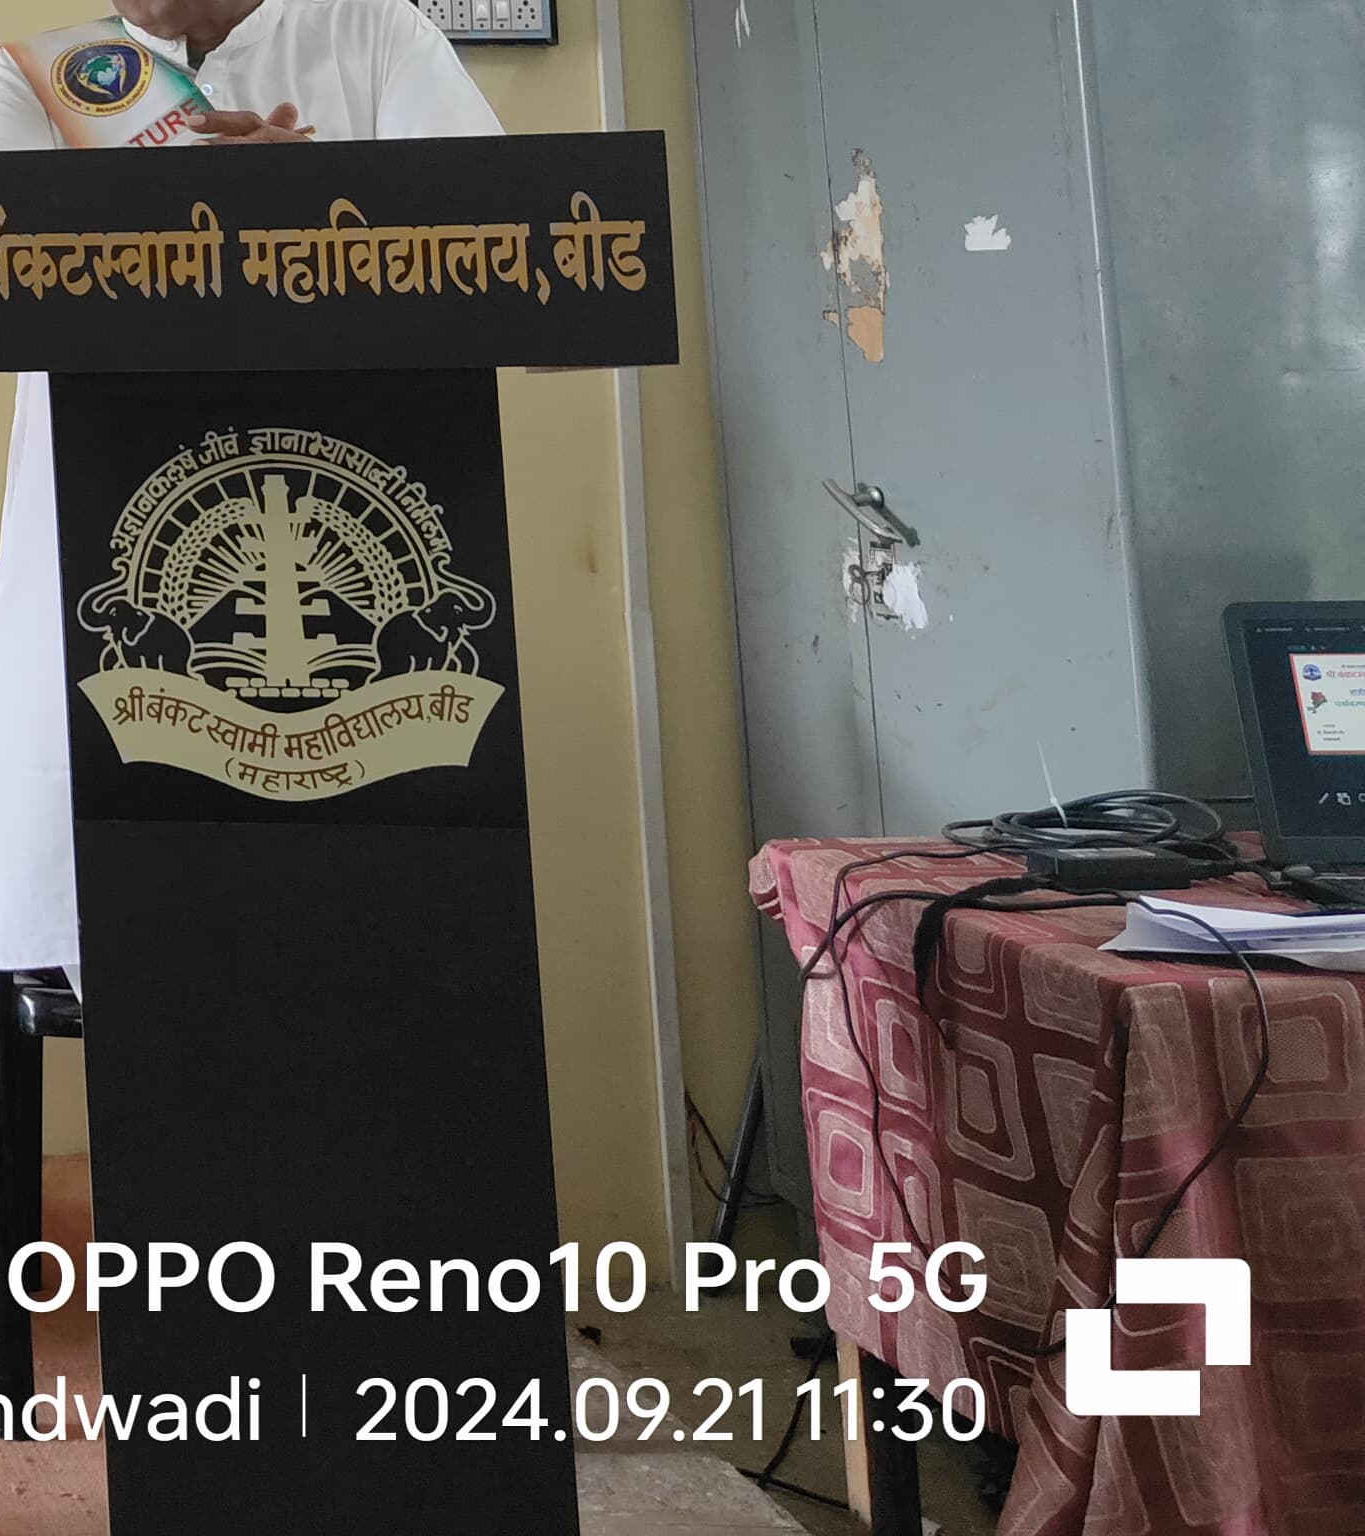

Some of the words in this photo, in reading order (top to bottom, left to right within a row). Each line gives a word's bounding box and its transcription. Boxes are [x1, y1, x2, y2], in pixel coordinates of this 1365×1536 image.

[550, 191, 646, 293] बीड
[199, 426, 238, 464] जीवं
[429, 685, 474, 723] बीड
